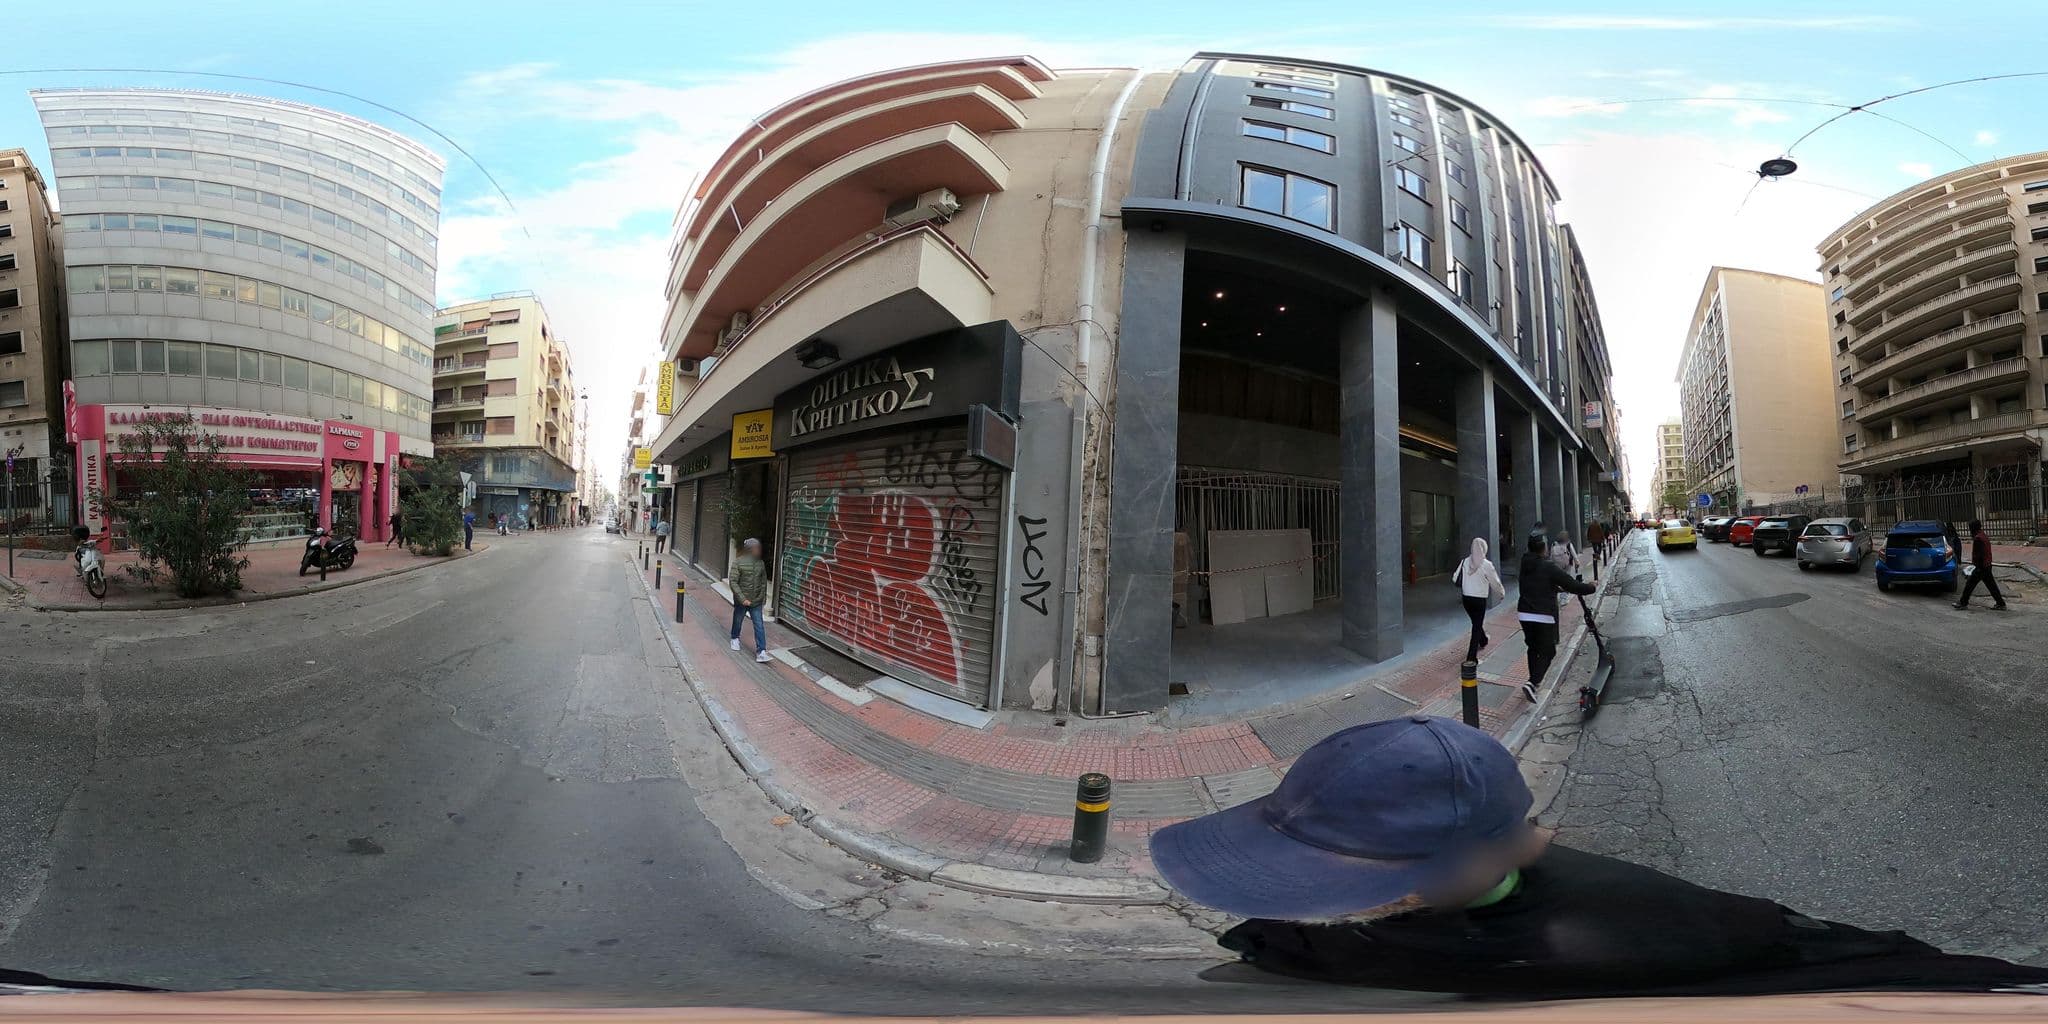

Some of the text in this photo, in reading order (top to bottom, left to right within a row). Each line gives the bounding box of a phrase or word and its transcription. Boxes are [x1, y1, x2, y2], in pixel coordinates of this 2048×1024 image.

[659, 362, 672, 409] AMBROSIA
[810, 356, 903, 409] ΟΠΤΙΚΑ
[202, 413, 230, 426] ΕΙΔΗ
[738, 434, 769, 443] AMBROSIA
